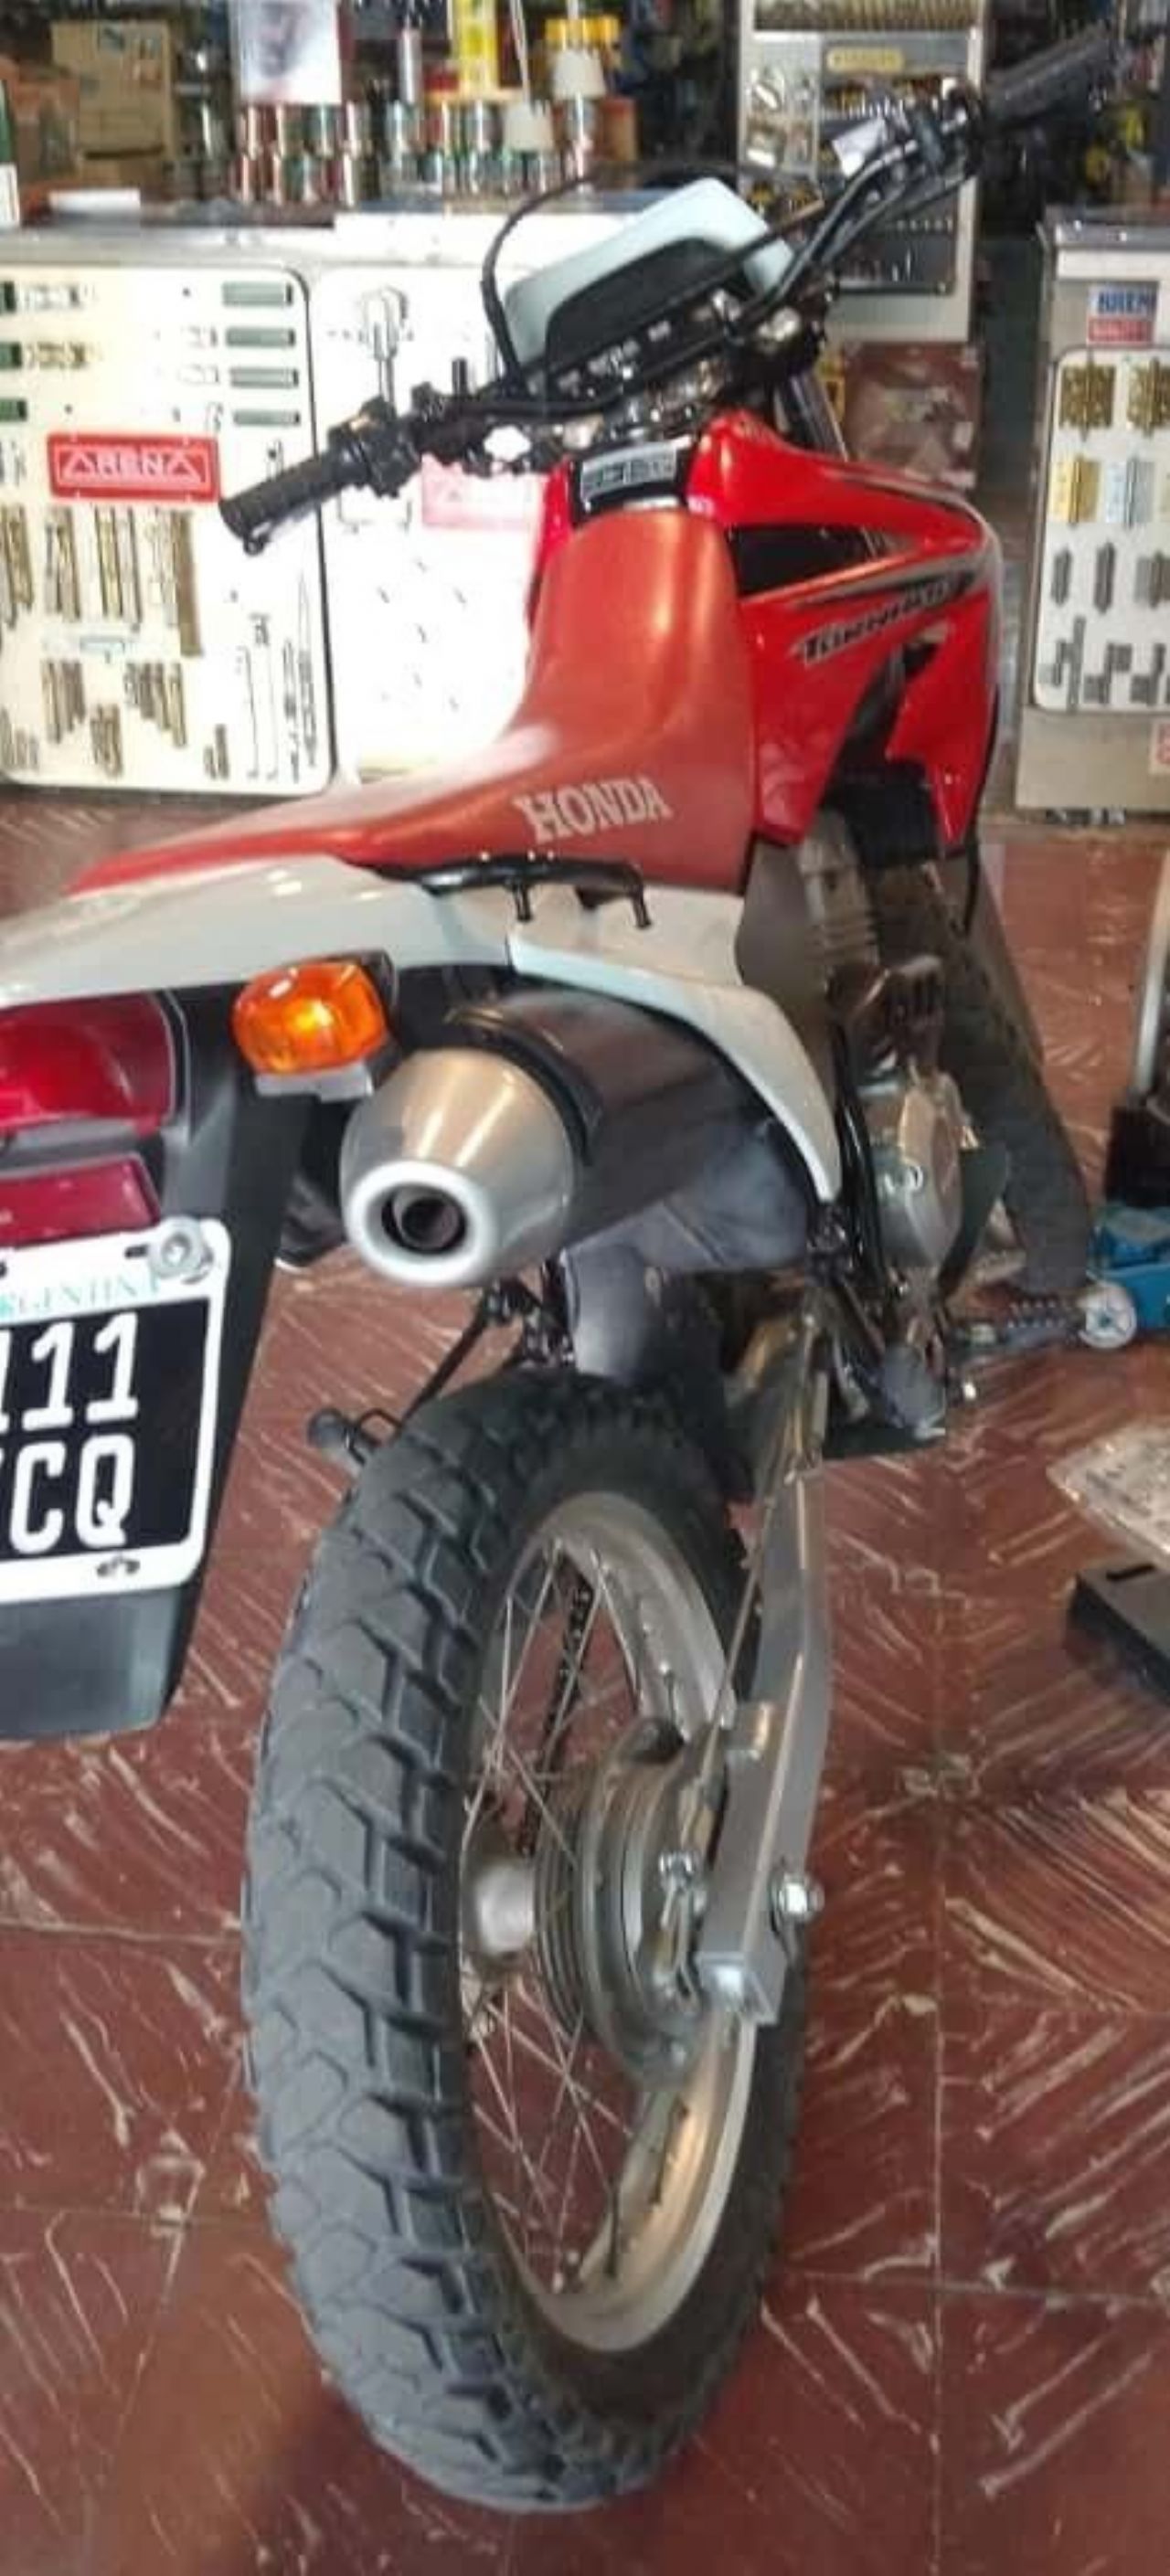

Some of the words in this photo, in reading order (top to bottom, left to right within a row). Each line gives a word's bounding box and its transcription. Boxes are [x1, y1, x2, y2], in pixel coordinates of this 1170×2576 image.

[60, 446, 203, 484] ARENA
[512, 775, 674, 844] HONDA
[0, 1434, 134, 1553] CQ
